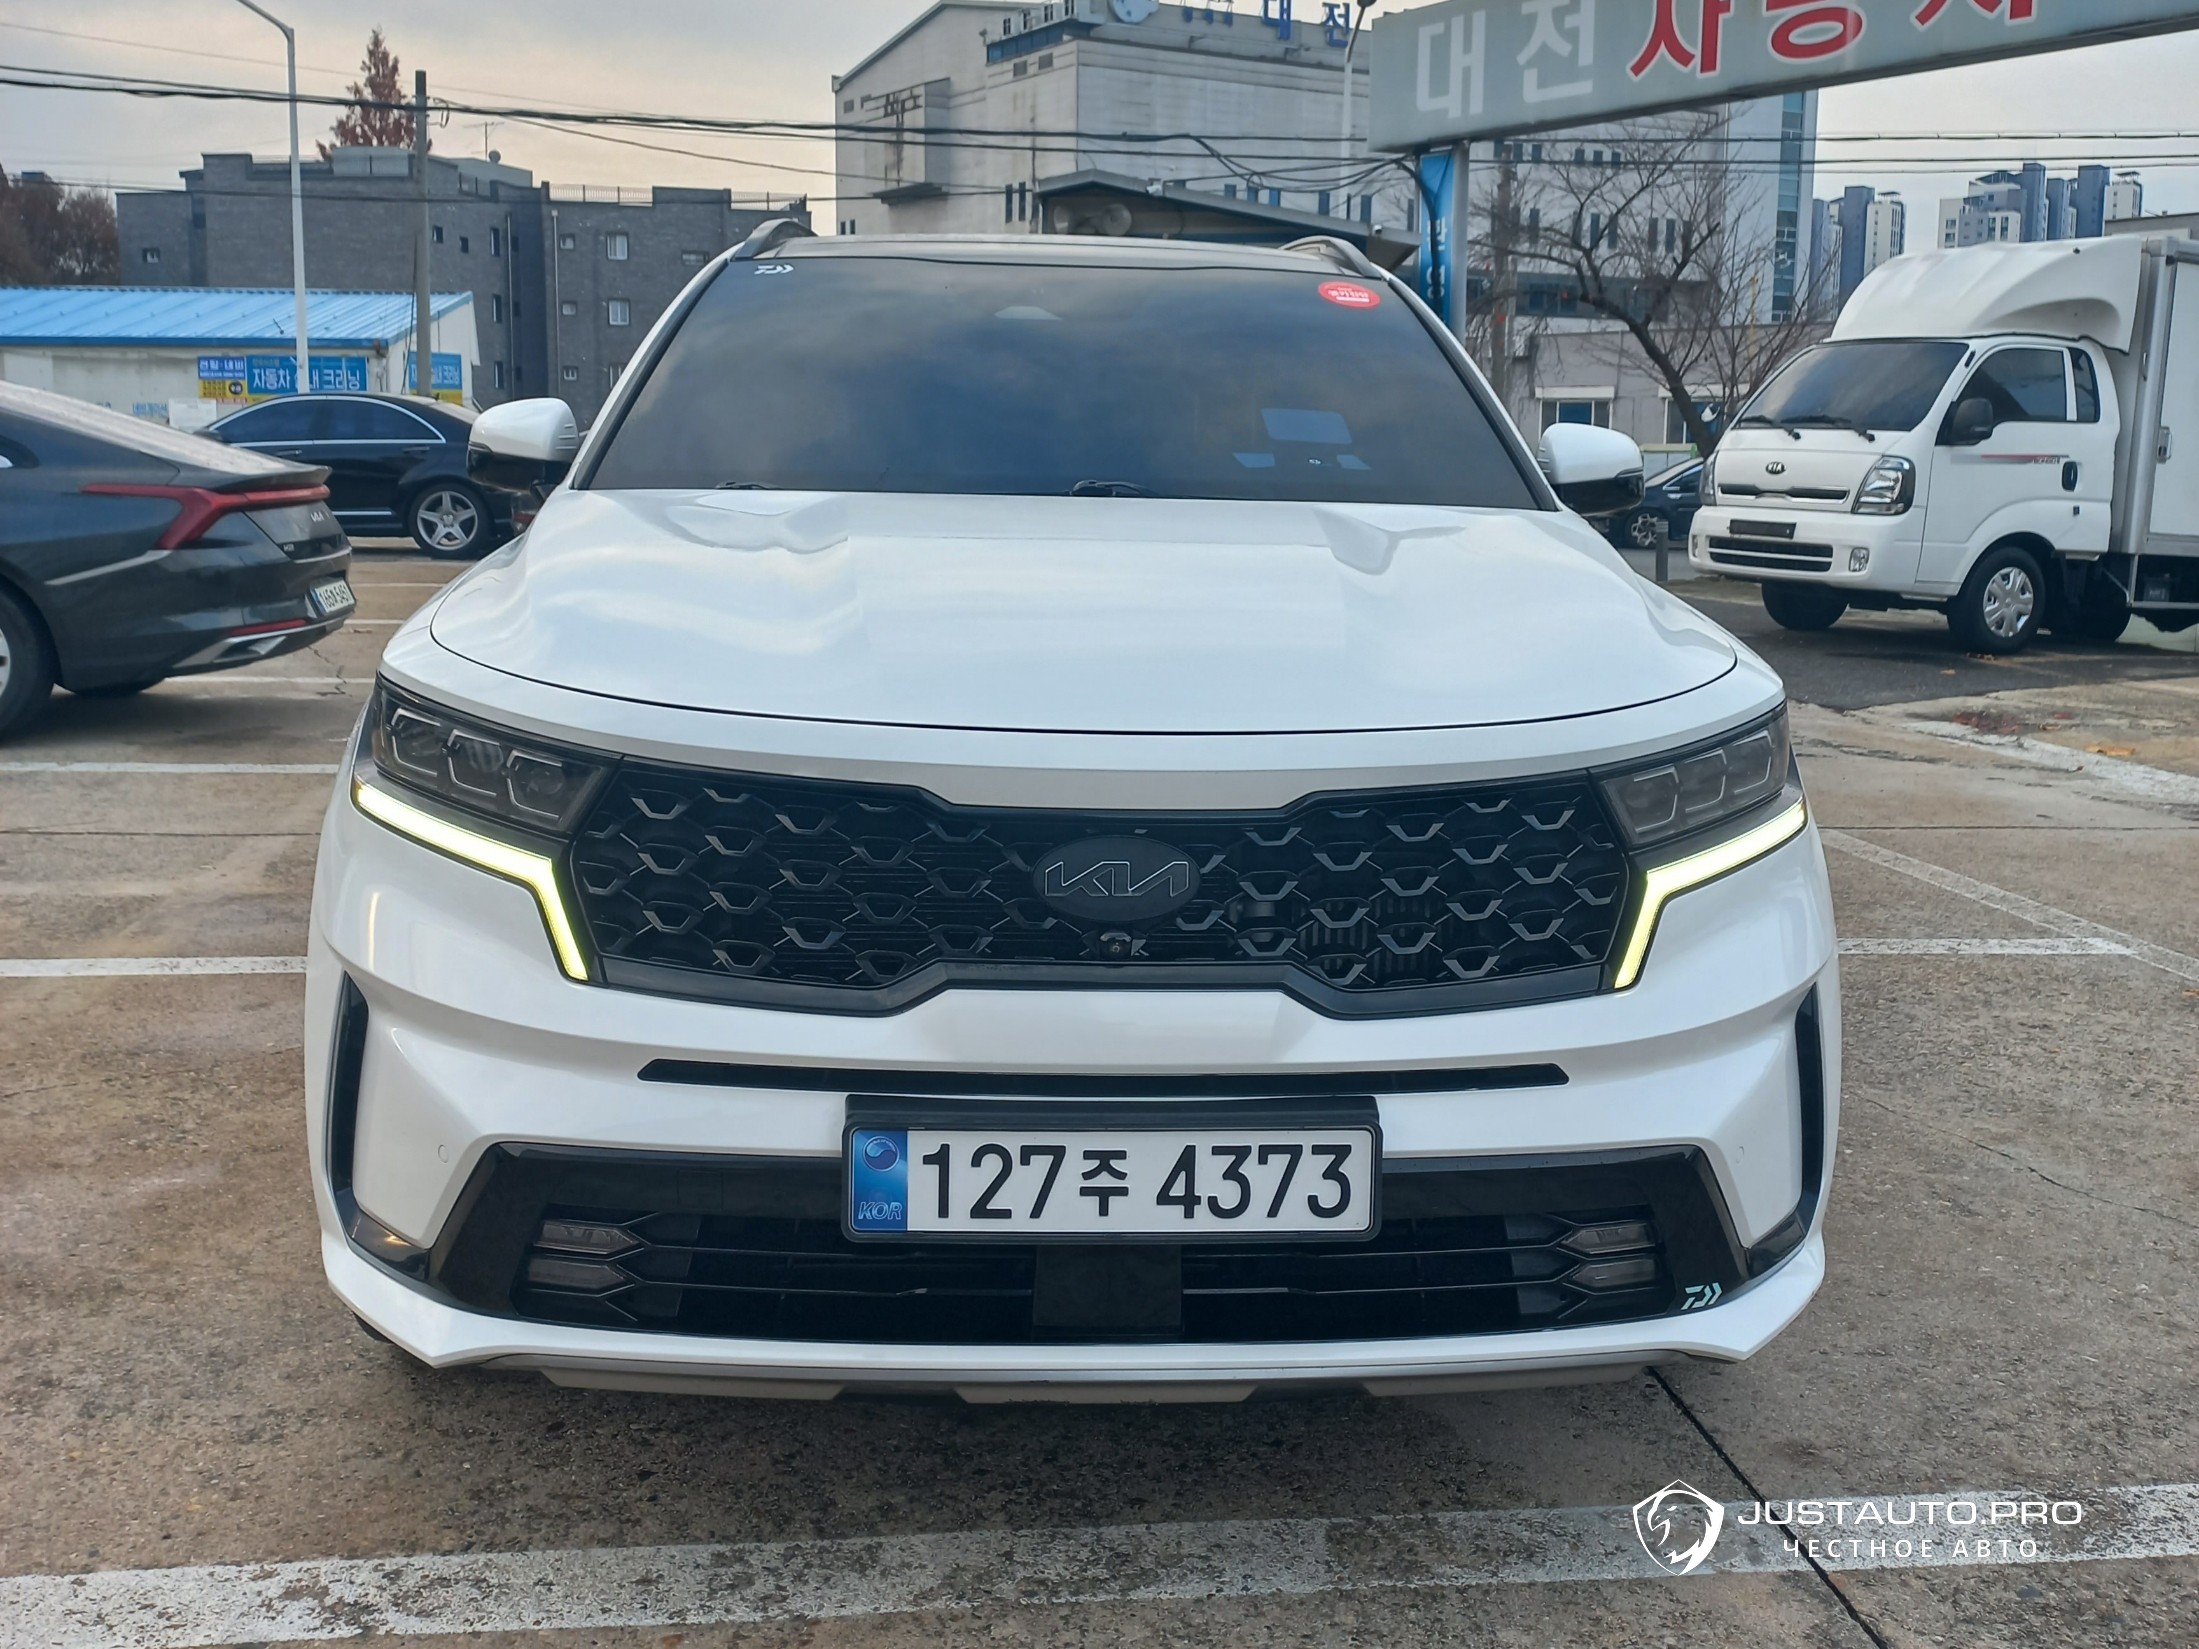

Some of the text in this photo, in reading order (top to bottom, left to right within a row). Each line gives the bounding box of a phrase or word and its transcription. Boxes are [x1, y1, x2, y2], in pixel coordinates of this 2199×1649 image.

[252, 368, 290, 390] 자동차
[1045, 861, 1189, 897] KIA
[922, 1143, 1352, 1219] 127주 4373
[858, 1201, 902, 1220] KOR
